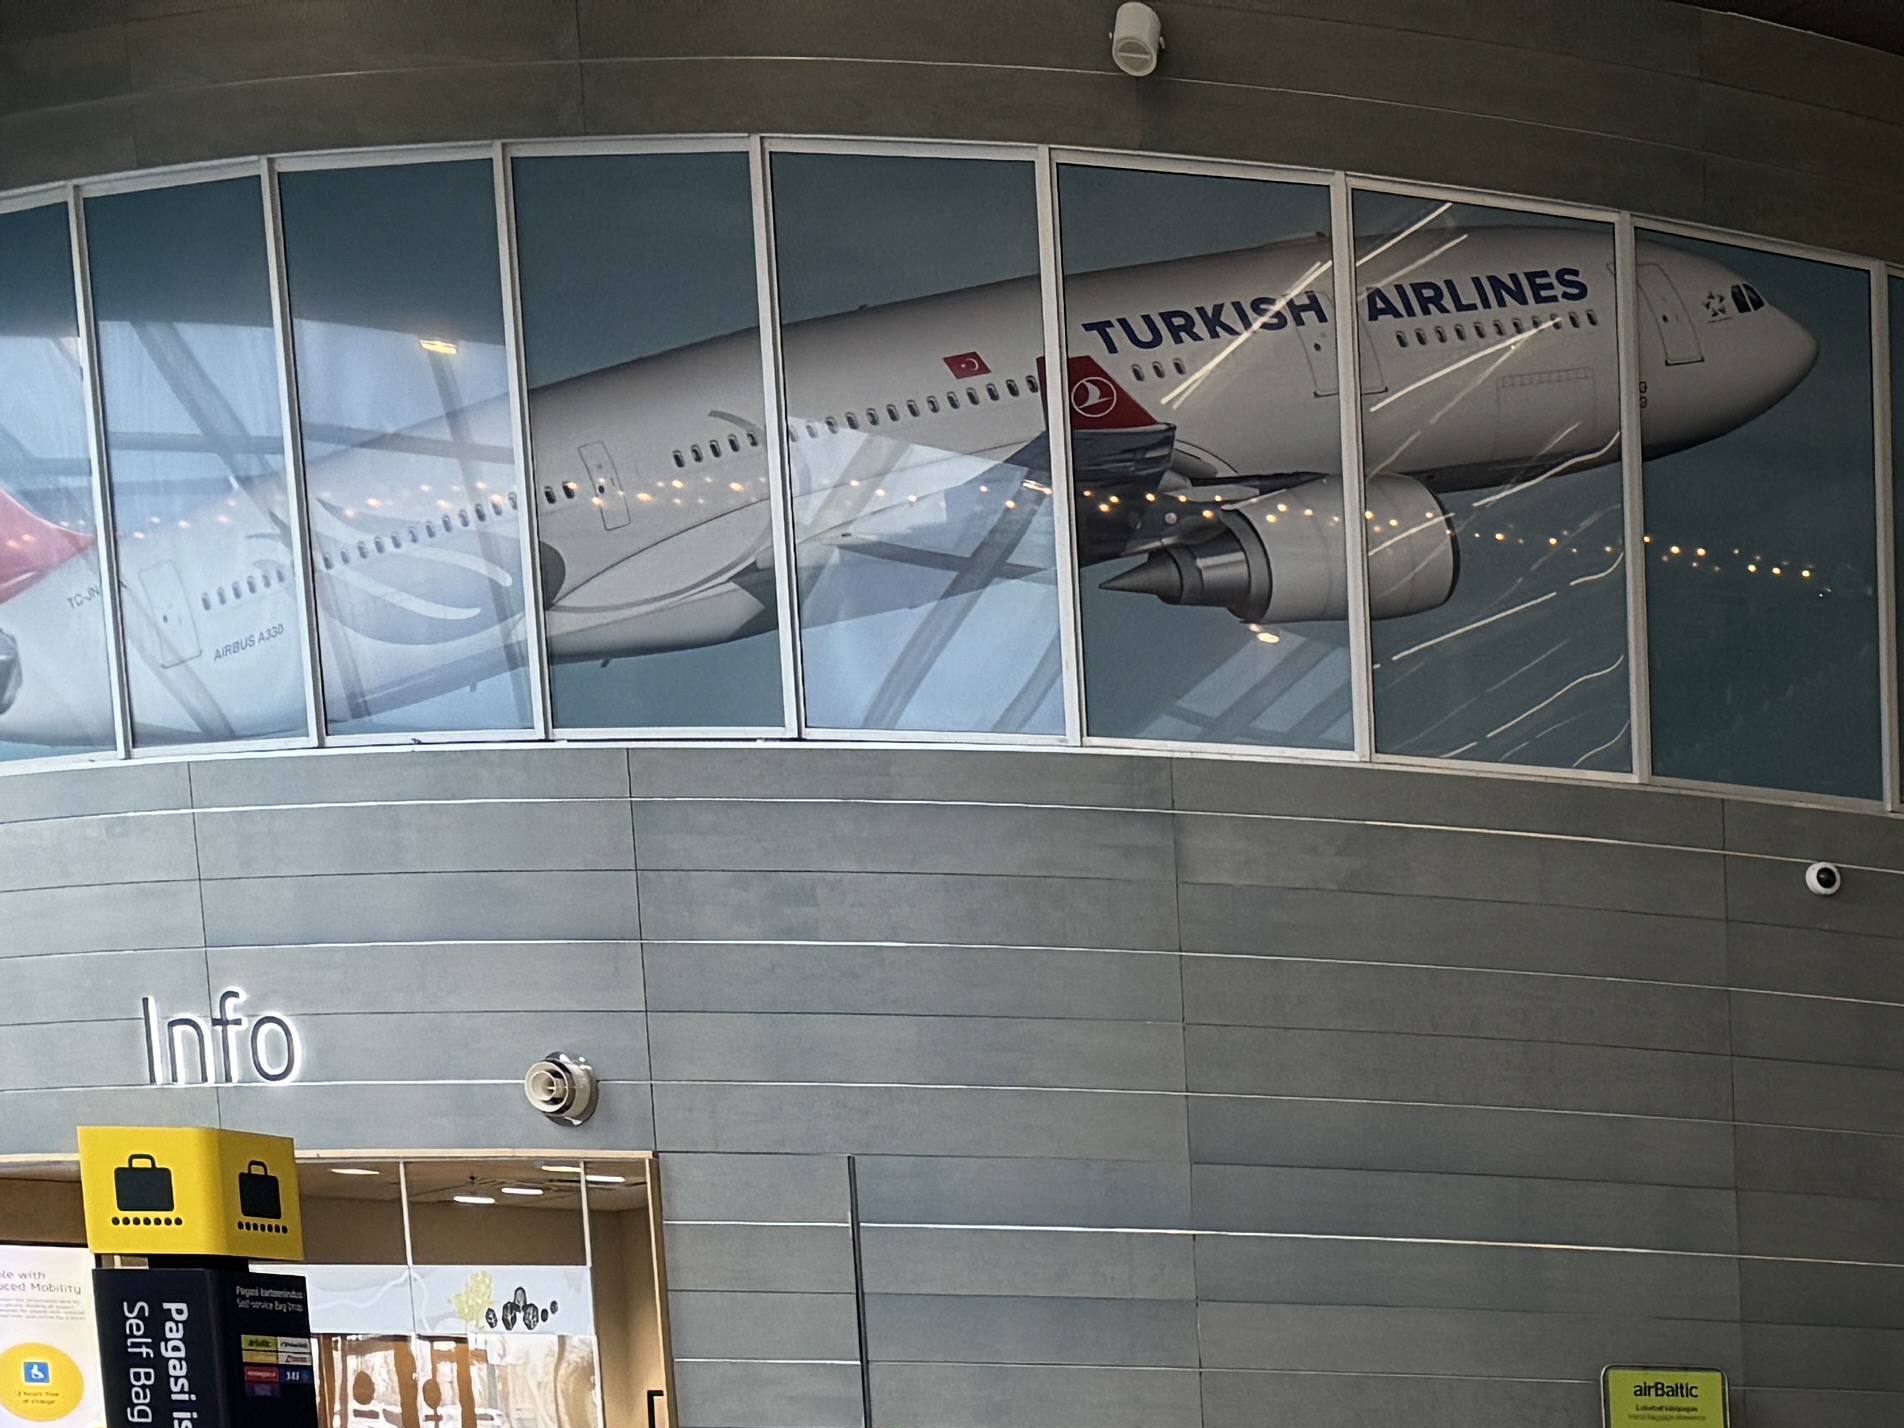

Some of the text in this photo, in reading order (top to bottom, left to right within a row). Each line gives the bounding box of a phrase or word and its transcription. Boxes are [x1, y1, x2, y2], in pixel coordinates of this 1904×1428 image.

[1081, 267, 1589, 355] TURKISH AIRLINES
[213, 623, 285, 661] AIRBUS A330
[142, 984, 296, 1083] Info
[123, 1301, 154, 1358] Self
[161, 1302, 197, 1401] Pagasi
[127, 1367, 155, 1423] Bag
[1633, 1381, 1699, 1399] airBaltic
